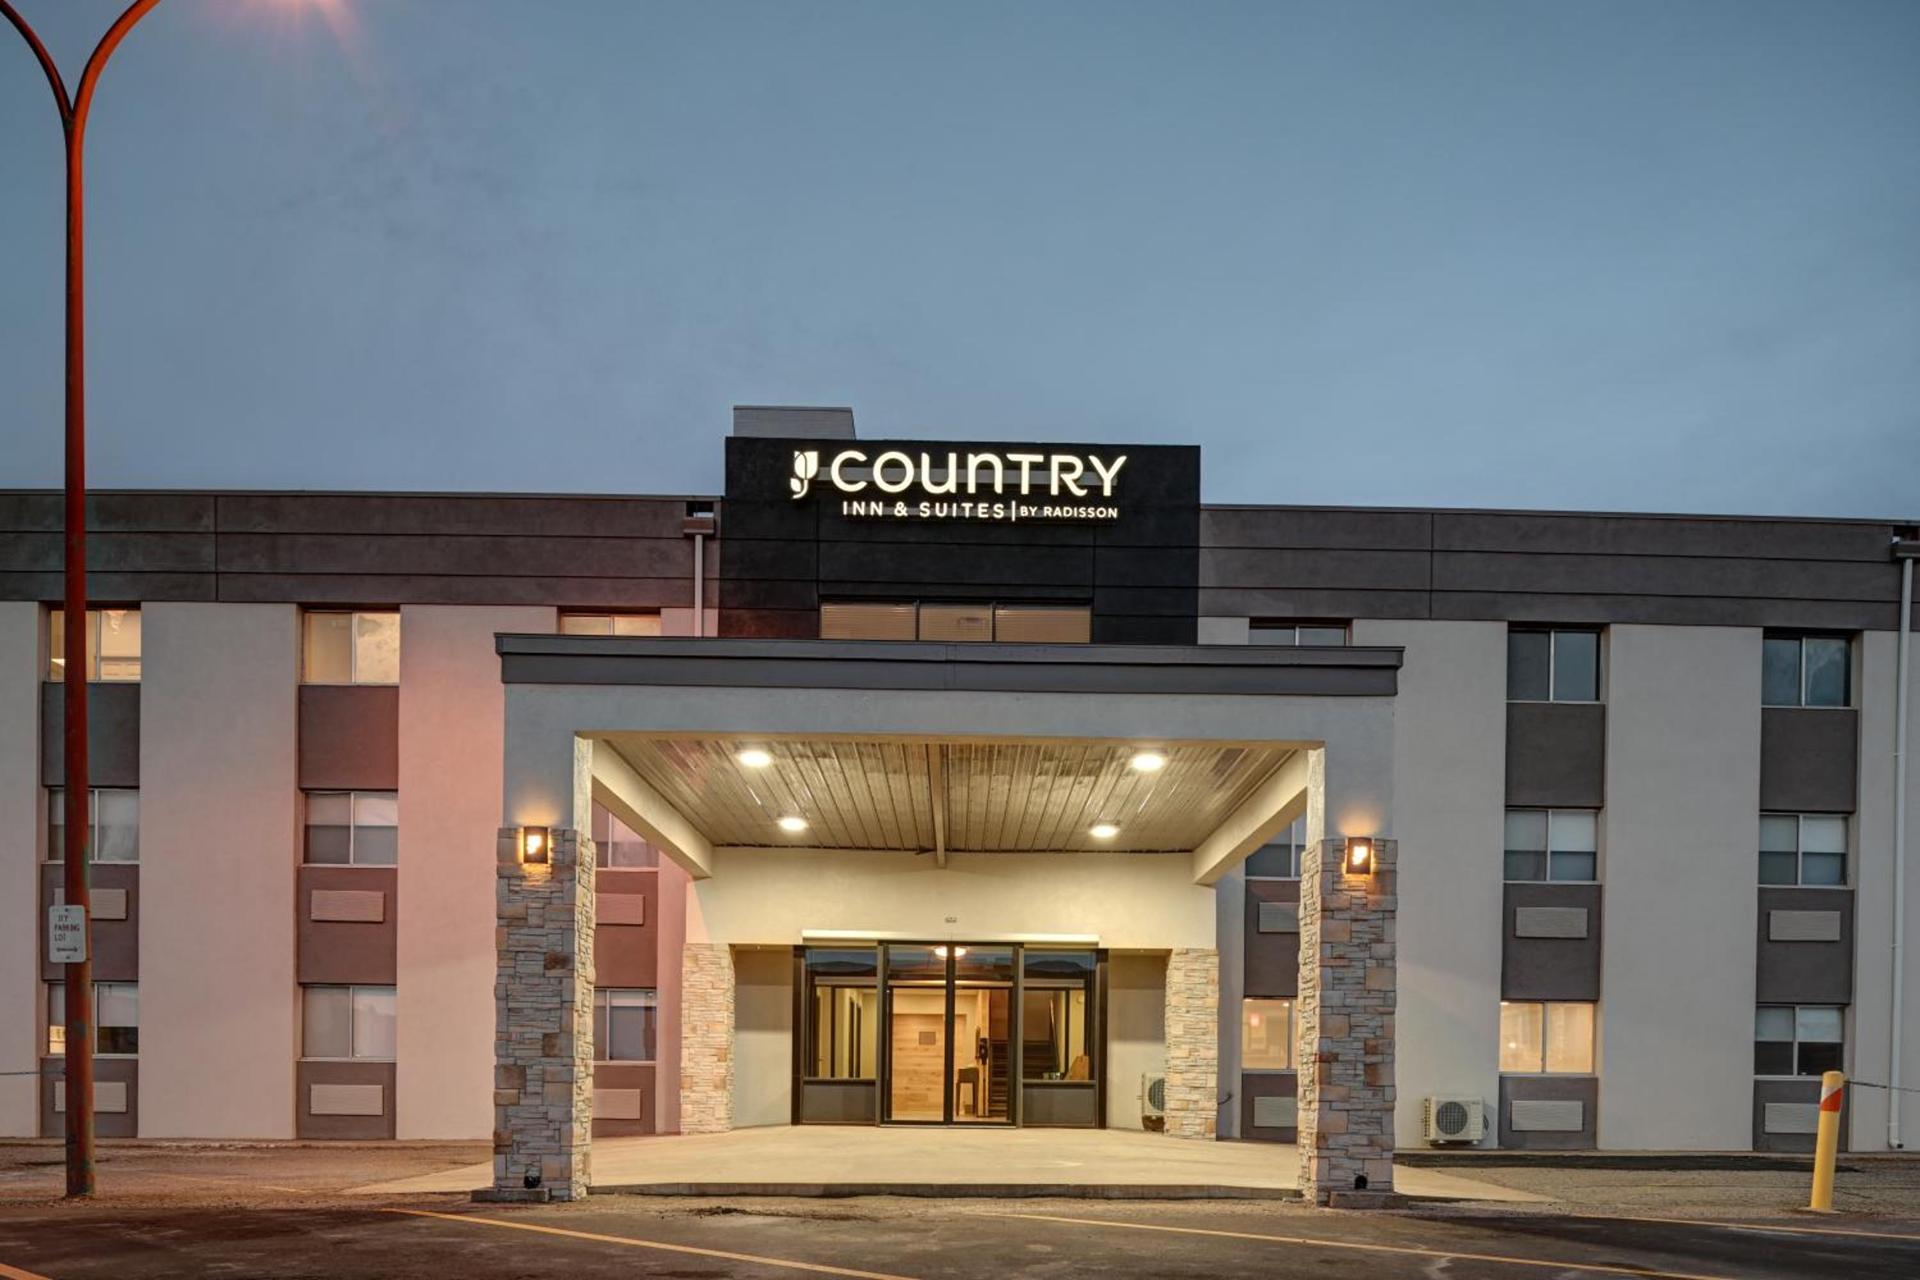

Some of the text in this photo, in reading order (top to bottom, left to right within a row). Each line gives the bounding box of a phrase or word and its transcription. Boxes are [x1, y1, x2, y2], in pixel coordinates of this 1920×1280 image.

[829, 449, 1128, 497] COUNTRY
[842, 500, 1119, 519] INN & SUITES BY RADISSON
